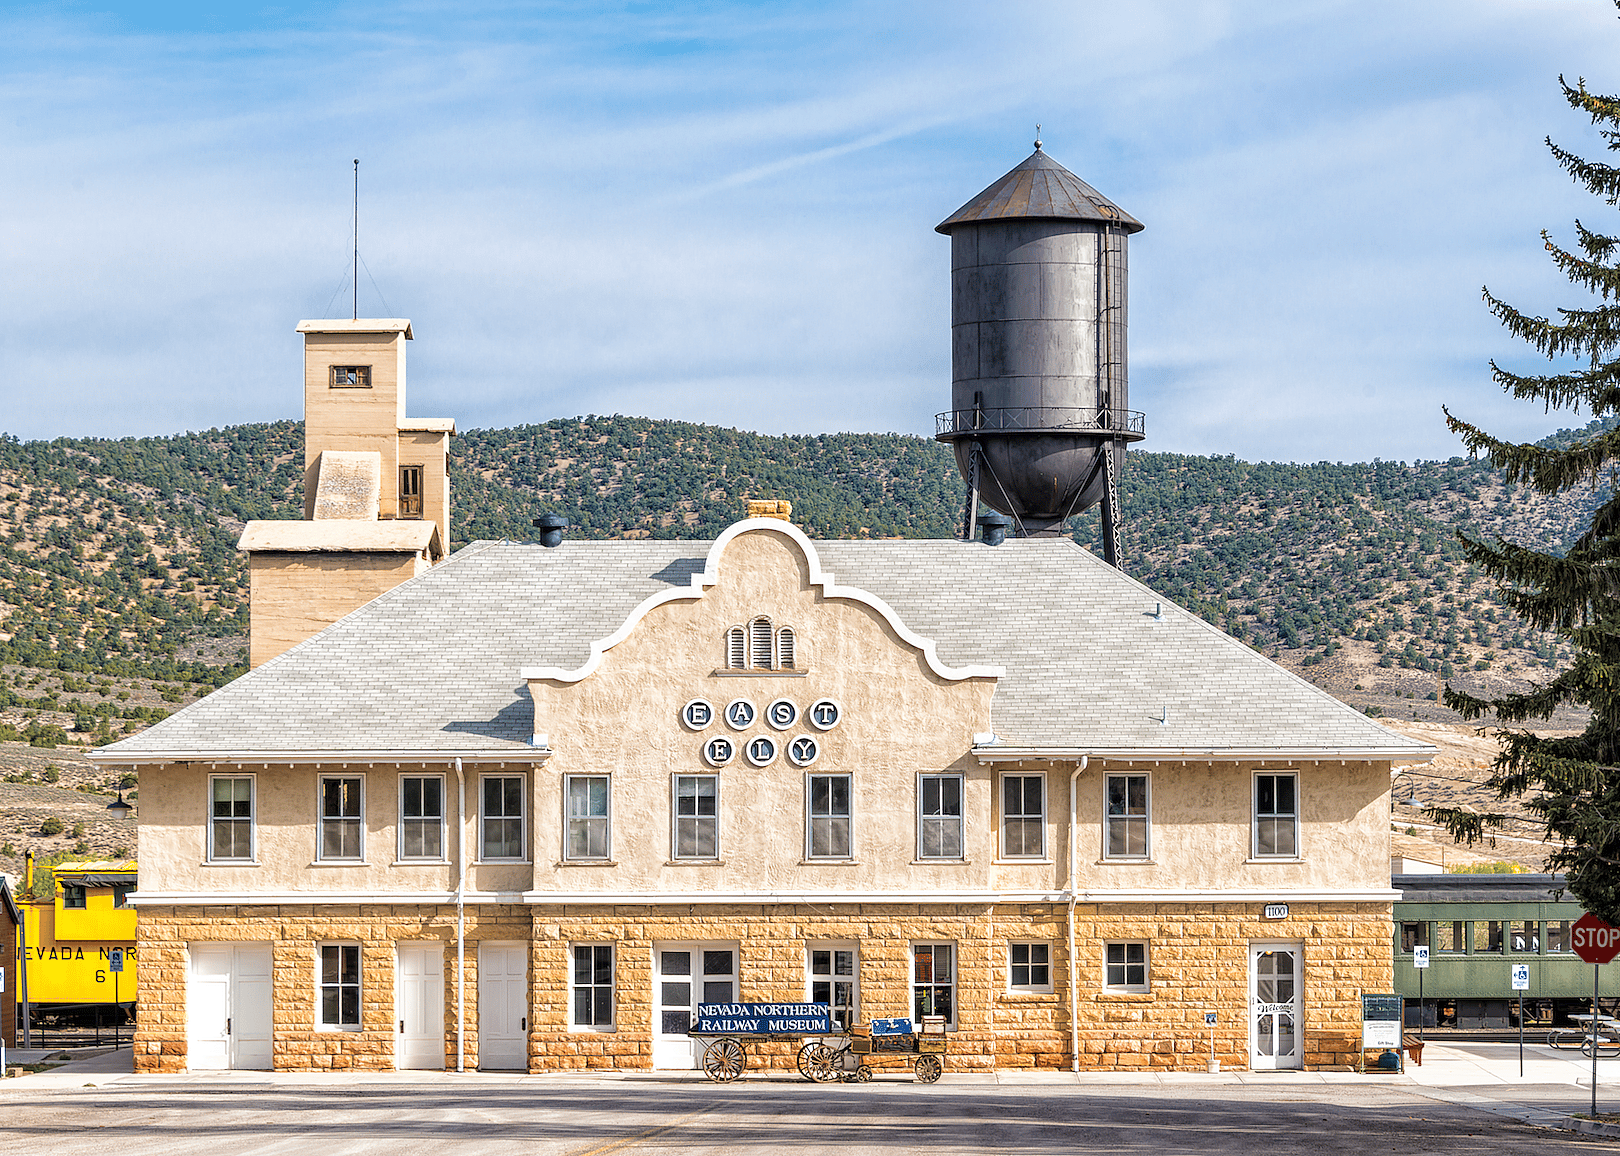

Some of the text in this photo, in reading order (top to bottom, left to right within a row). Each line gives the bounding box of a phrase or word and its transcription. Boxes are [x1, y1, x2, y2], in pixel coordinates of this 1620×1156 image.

[690, 702, 835, 724] EAST
[712, 740, 813, 761] ELY
[1268, 906, 1286, 917] 1100
[1574, 927, 1620, 948] STOP
[95, 969, 106, 983] 6
[699, 1004, 828, 1016] NEVADA NORTHERN
[701, 1019, 826, 1031] RAILWAY MUSEUM
